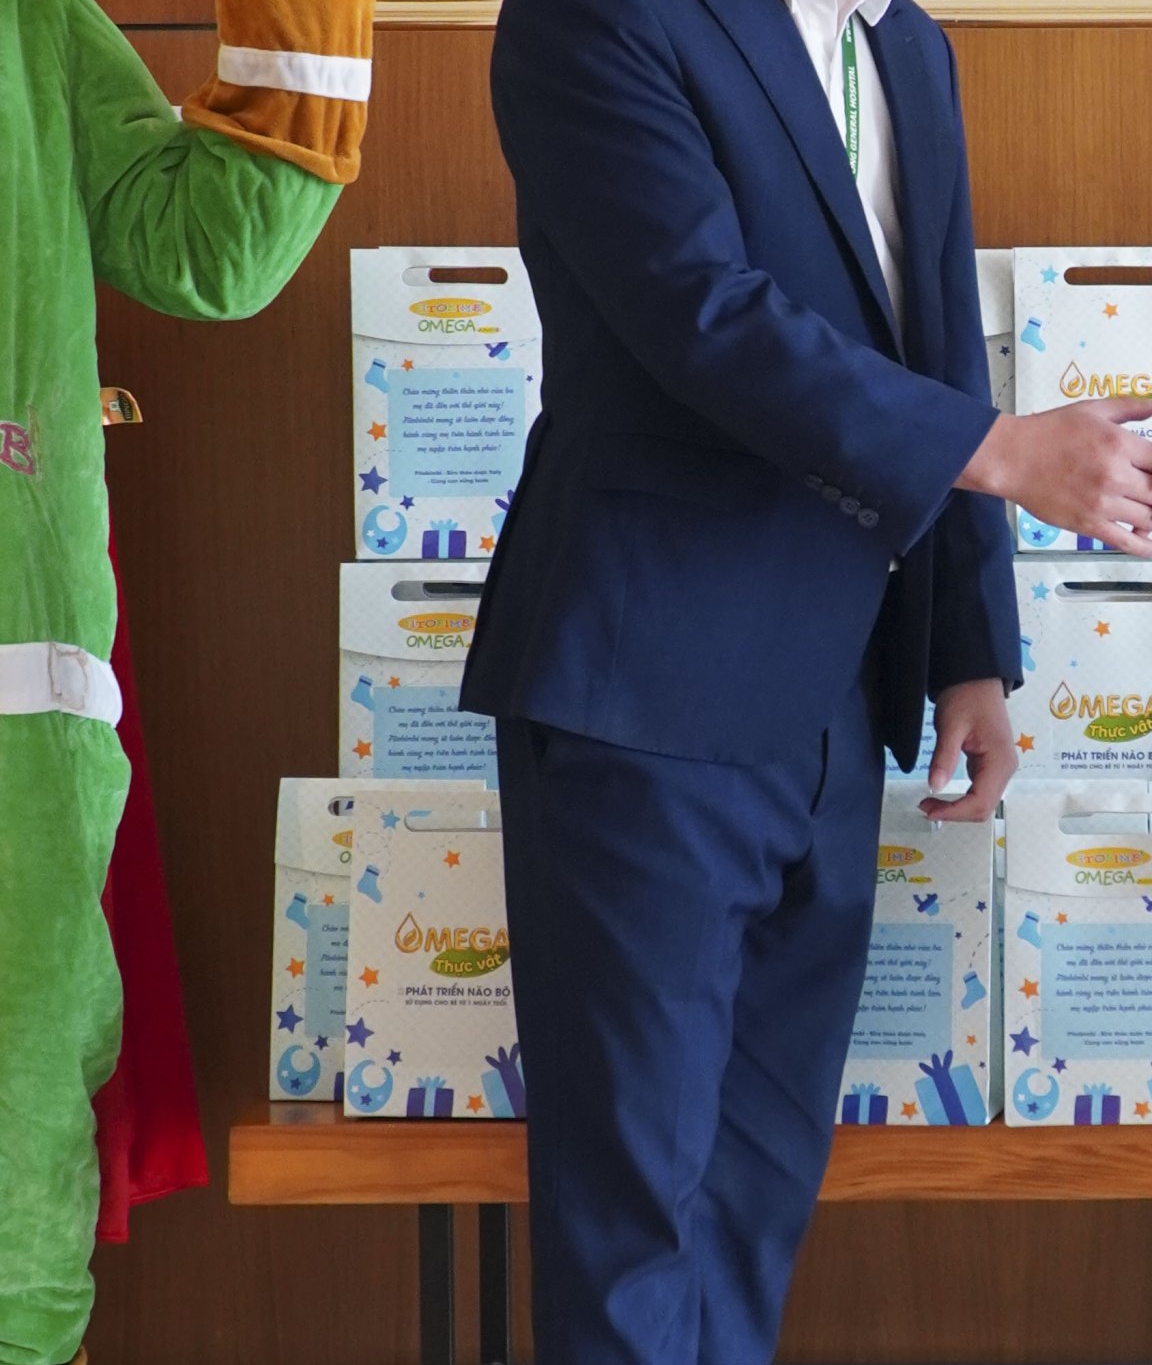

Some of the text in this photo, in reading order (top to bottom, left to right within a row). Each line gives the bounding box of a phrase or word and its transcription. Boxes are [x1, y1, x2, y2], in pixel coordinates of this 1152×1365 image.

[848, 66, 857, 108] HOSPITAL
[418, 319, 476, 333] OMEGA
[407, 635, 464, 649] OMEGA
[1089, 725, 1126, 741] Thực
[1061, 750, 1087, 760] PHÁT
[876, 869, 907, 883] EGA
[1075, 871, 1135, 885] OMEGA
[435, 954, 502, 977] Thực vật
[406, 984, 432, 995] PHÁT
[436, 982, 464, 995] TRIỂN
